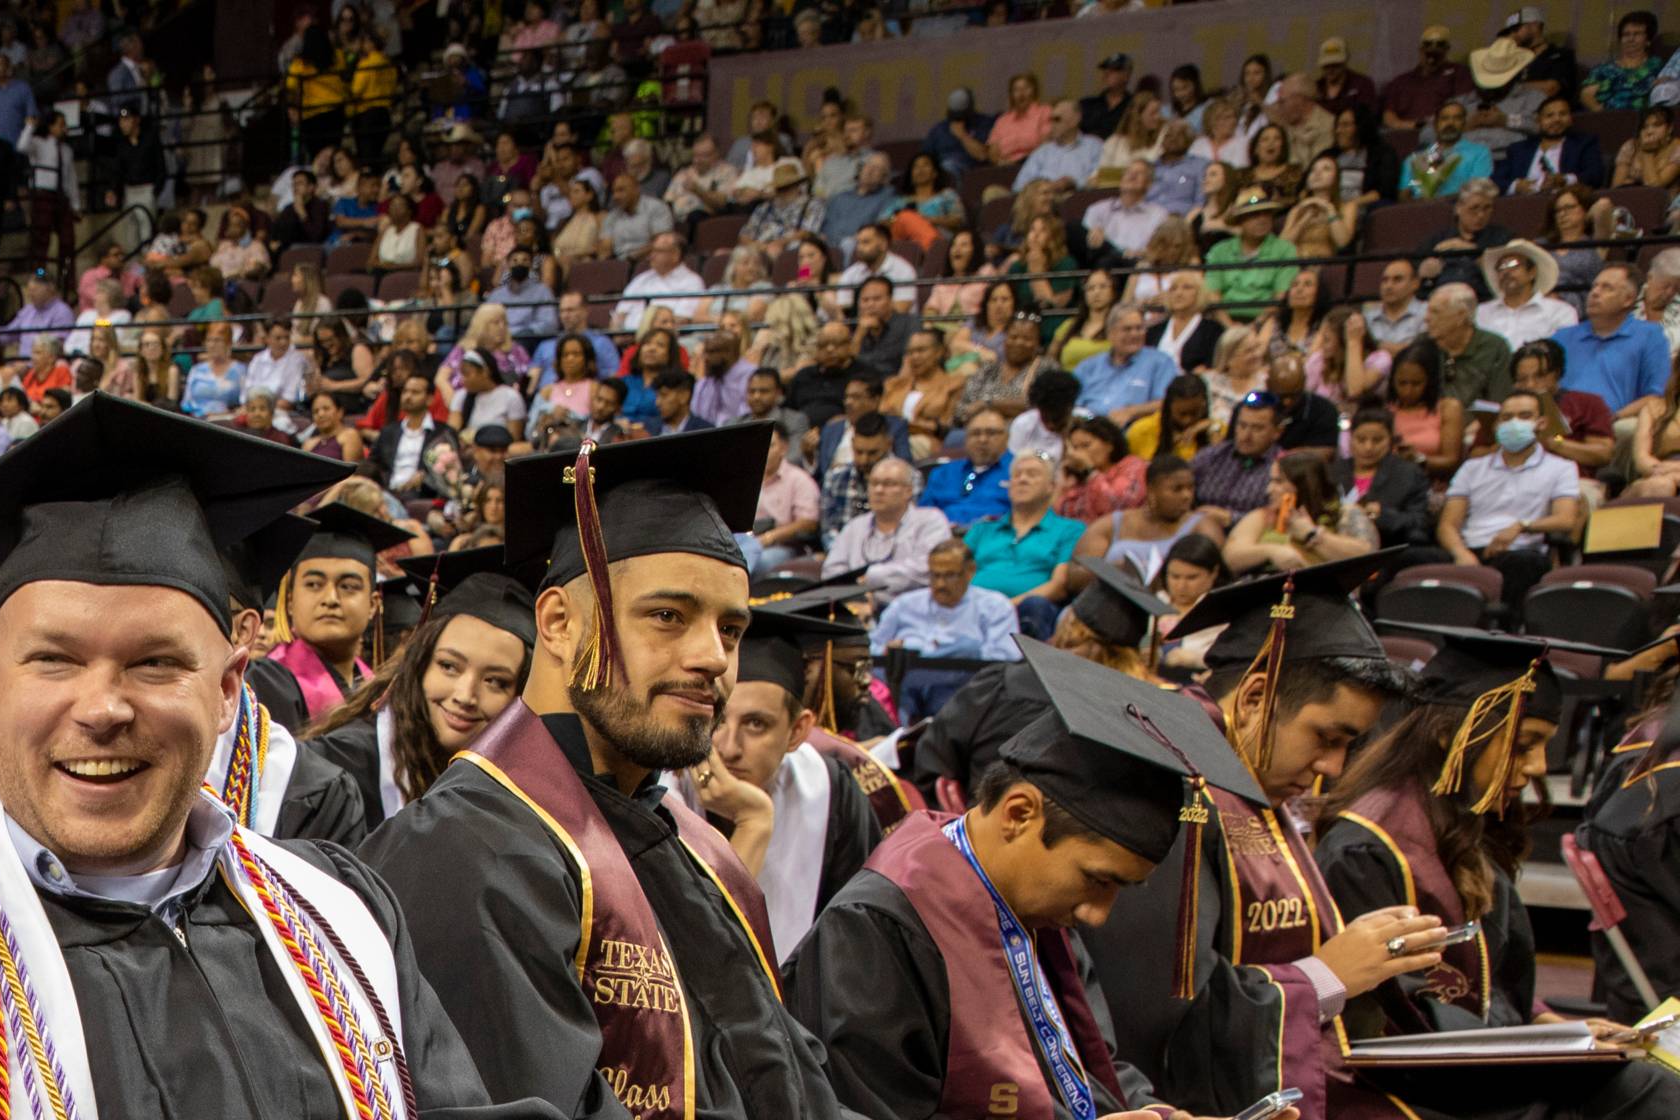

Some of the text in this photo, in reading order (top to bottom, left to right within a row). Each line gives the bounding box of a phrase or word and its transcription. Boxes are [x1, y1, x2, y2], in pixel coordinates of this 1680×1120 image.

[1179, 806, 1209, 824] 2022
[1248, 897, 1307, 933] 2022
[600, 939, 672, 977] TEXAS
[594, 976, 680, 1013] STATE
[1014, 951, 1031, 984] SUN
[1024, 986, 1042, 1023] BELT
[989, 1083, 1018, 1114] S
